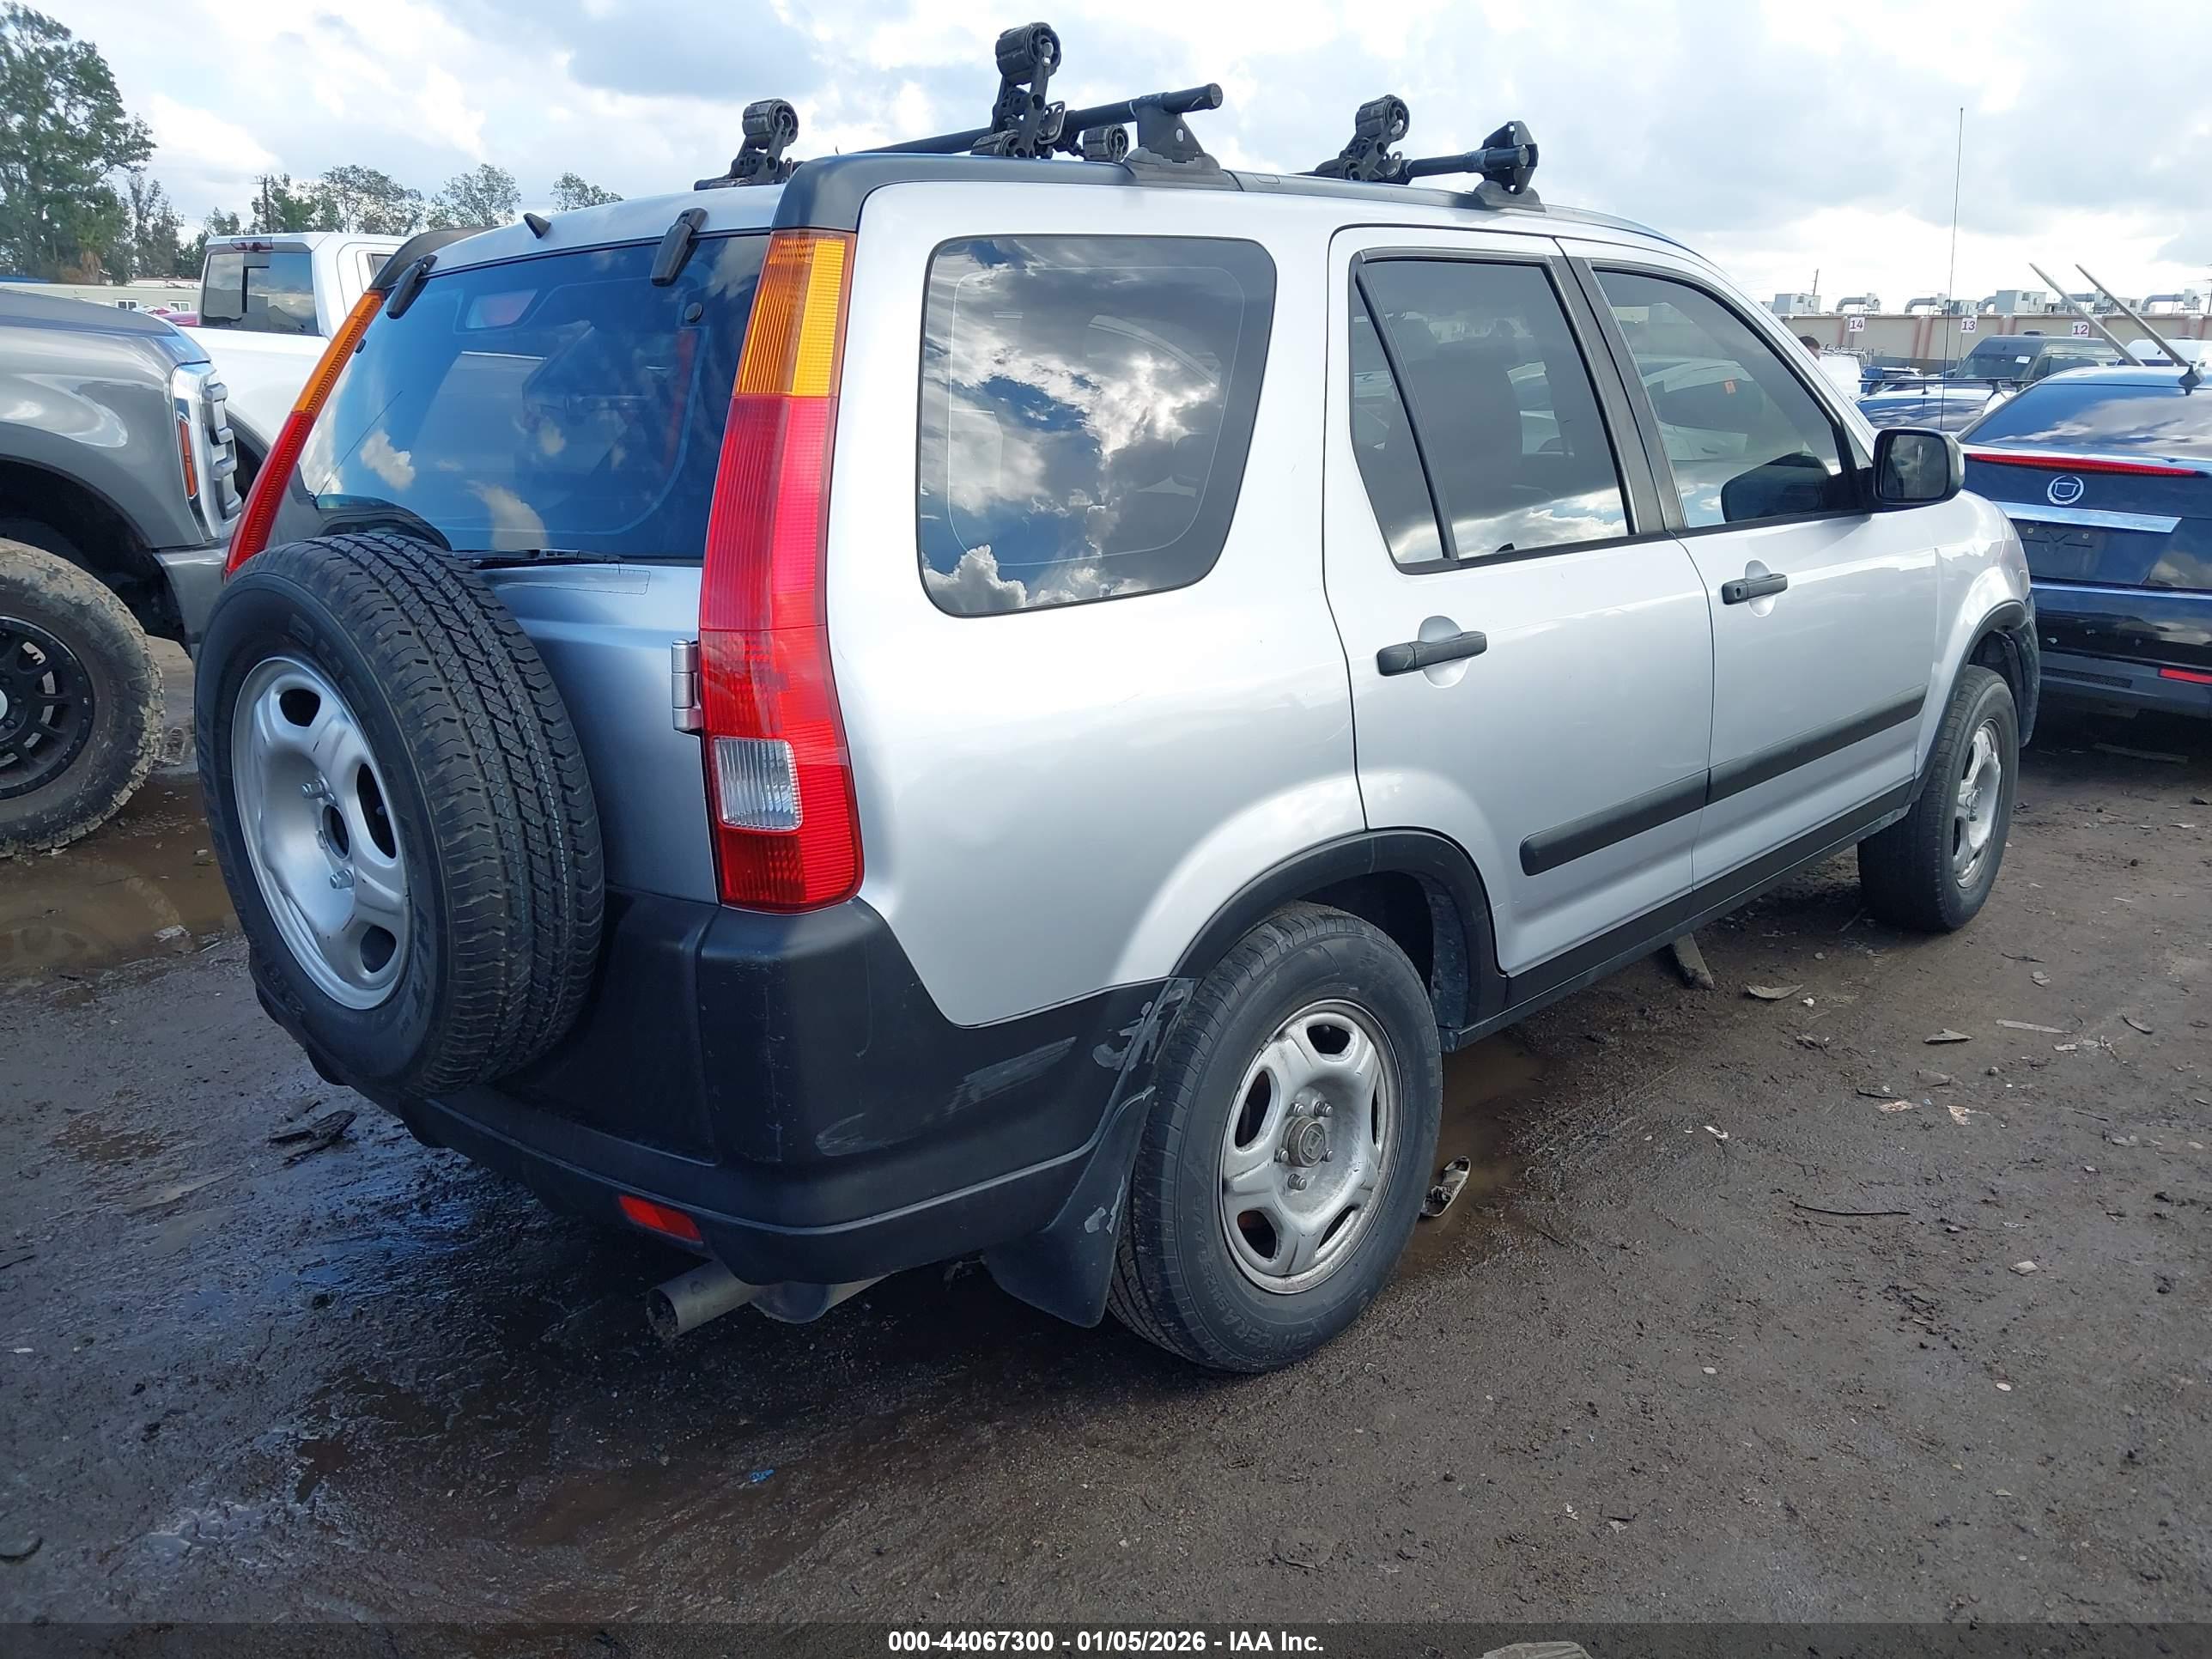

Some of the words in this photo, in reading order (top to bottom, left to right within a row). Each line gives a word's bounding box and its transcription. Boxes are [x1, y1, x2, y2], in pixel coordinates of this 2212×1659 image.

[1850, 319, 1863, 330] 14
[1962, 321, 1976, 331] 13
[2073, 325, 2088, 335] 12
